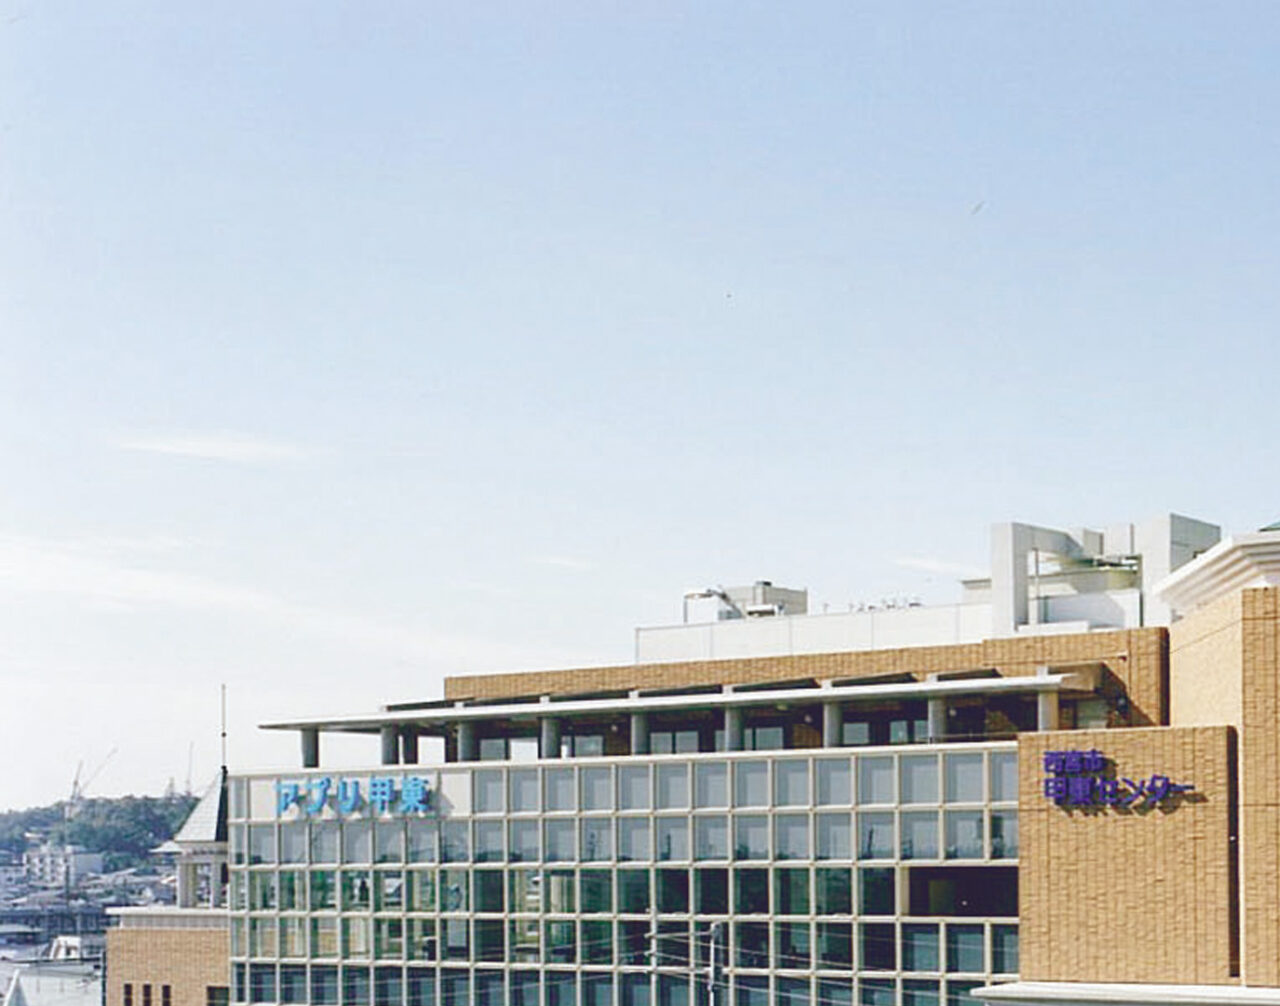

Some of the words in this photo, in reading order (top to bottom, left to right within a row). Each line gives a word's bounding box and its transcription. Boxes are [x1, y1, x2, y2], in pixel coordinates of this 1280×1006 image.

[274, 776, 430, 814] アプリ甲東
[1044, 774, 1196, 806] 甲東センター
